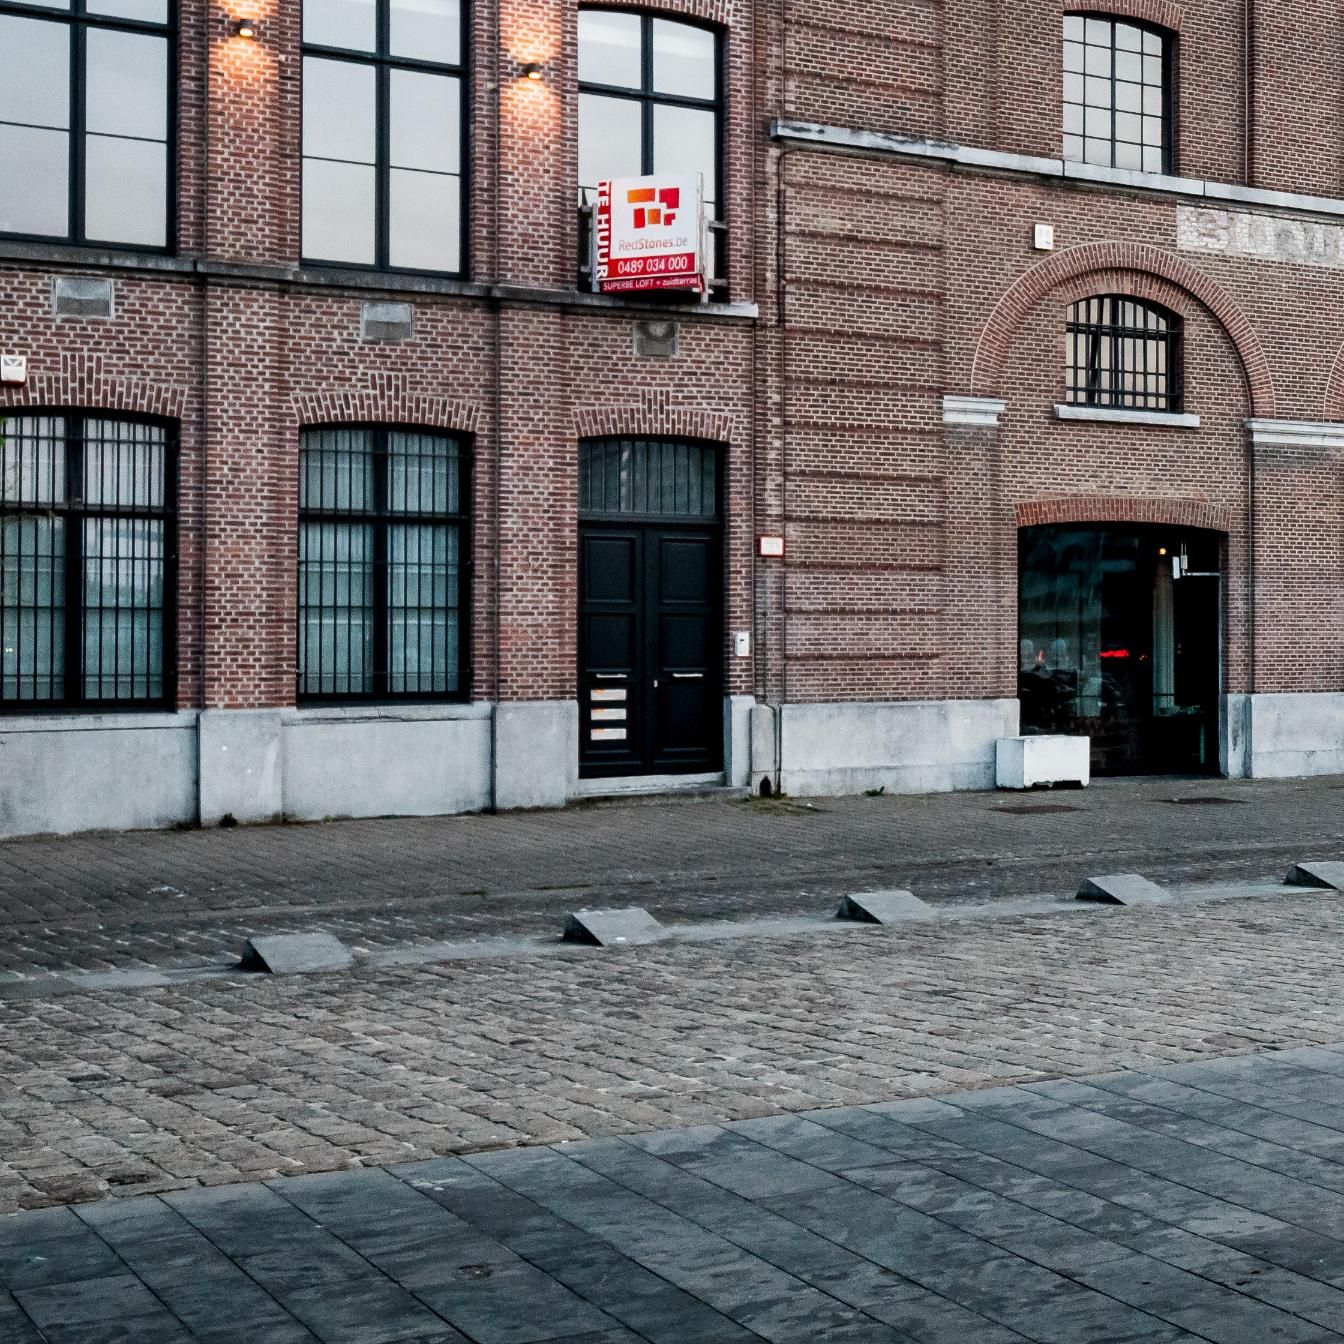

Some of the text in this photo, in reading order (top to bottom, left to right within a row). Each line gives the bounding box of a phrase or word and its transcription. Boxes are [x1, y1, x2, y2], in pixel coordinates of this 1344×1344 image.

[596, 182, 609, 279] TE HUUR
[618, 237, 688, 251] RedStones.be
[617, 257, 688, 274] 0489 034 000
[603, 280, 634, 290] SUPERBE
[635, 278, 653, 289] LOFT
